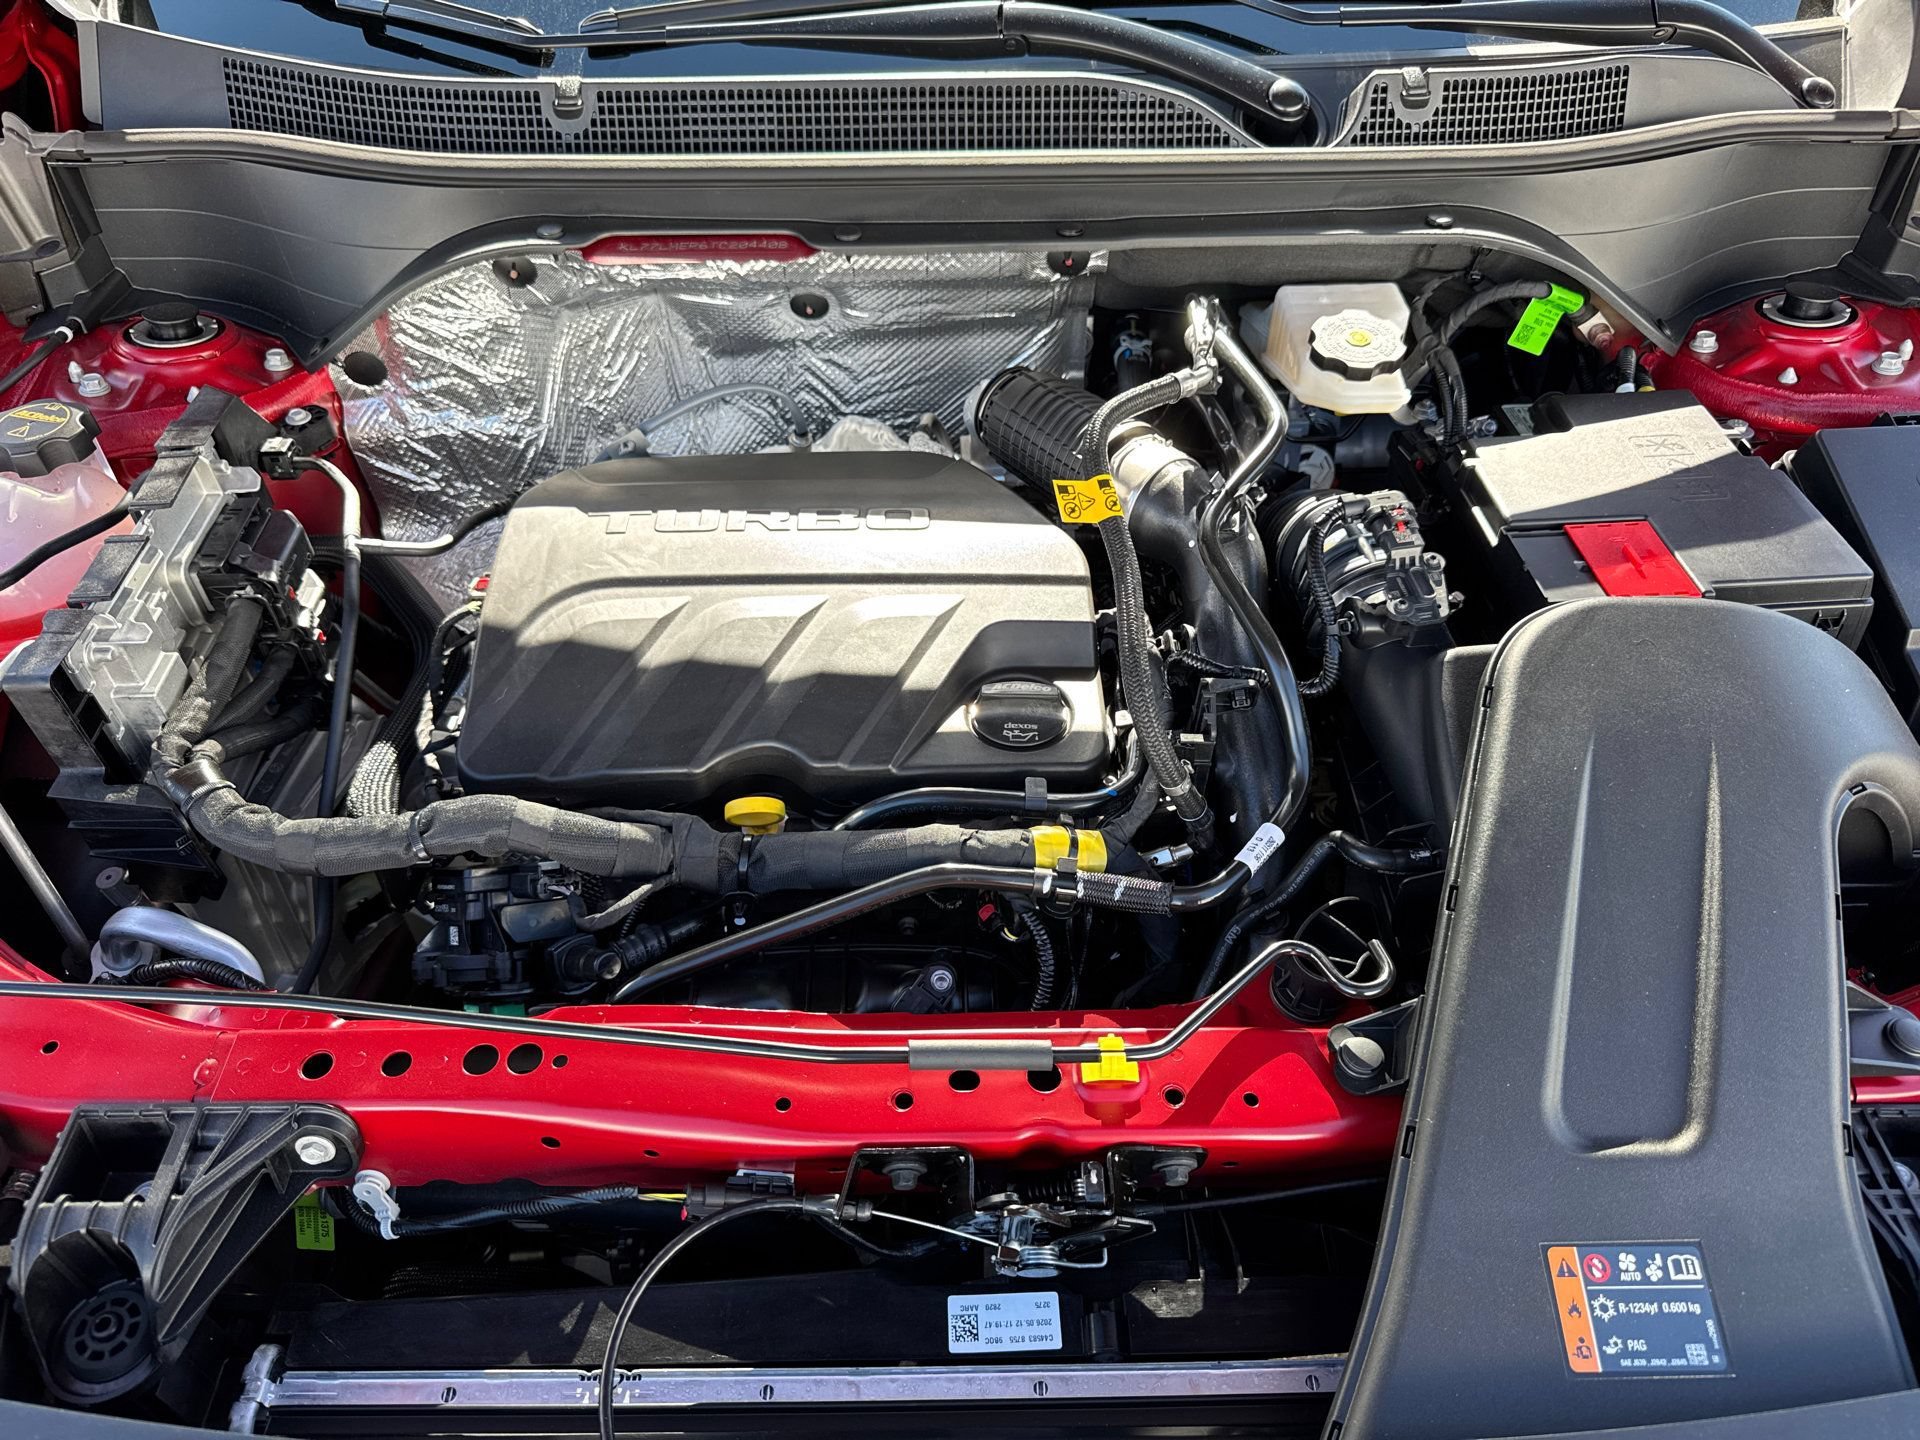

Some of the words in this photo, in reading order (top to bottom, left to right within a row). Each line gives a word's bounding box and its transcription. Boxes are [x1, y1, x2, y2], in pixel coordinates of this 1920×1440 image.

[588, 509, 930, 534] TURBO
[991, 682, 1052, 692] ACDelco
[1004, 722, 1038, 730] dexos
[1620, 1271, 1641, 1281] AUTO
[1618, 1302, 1658, 1315] R-1234yf
[1662, 1302, 1687, 1313] 0.600
[1688, 1302, 1701, 1315] kg
[1627, 1339, 1647, 1351] PAG
